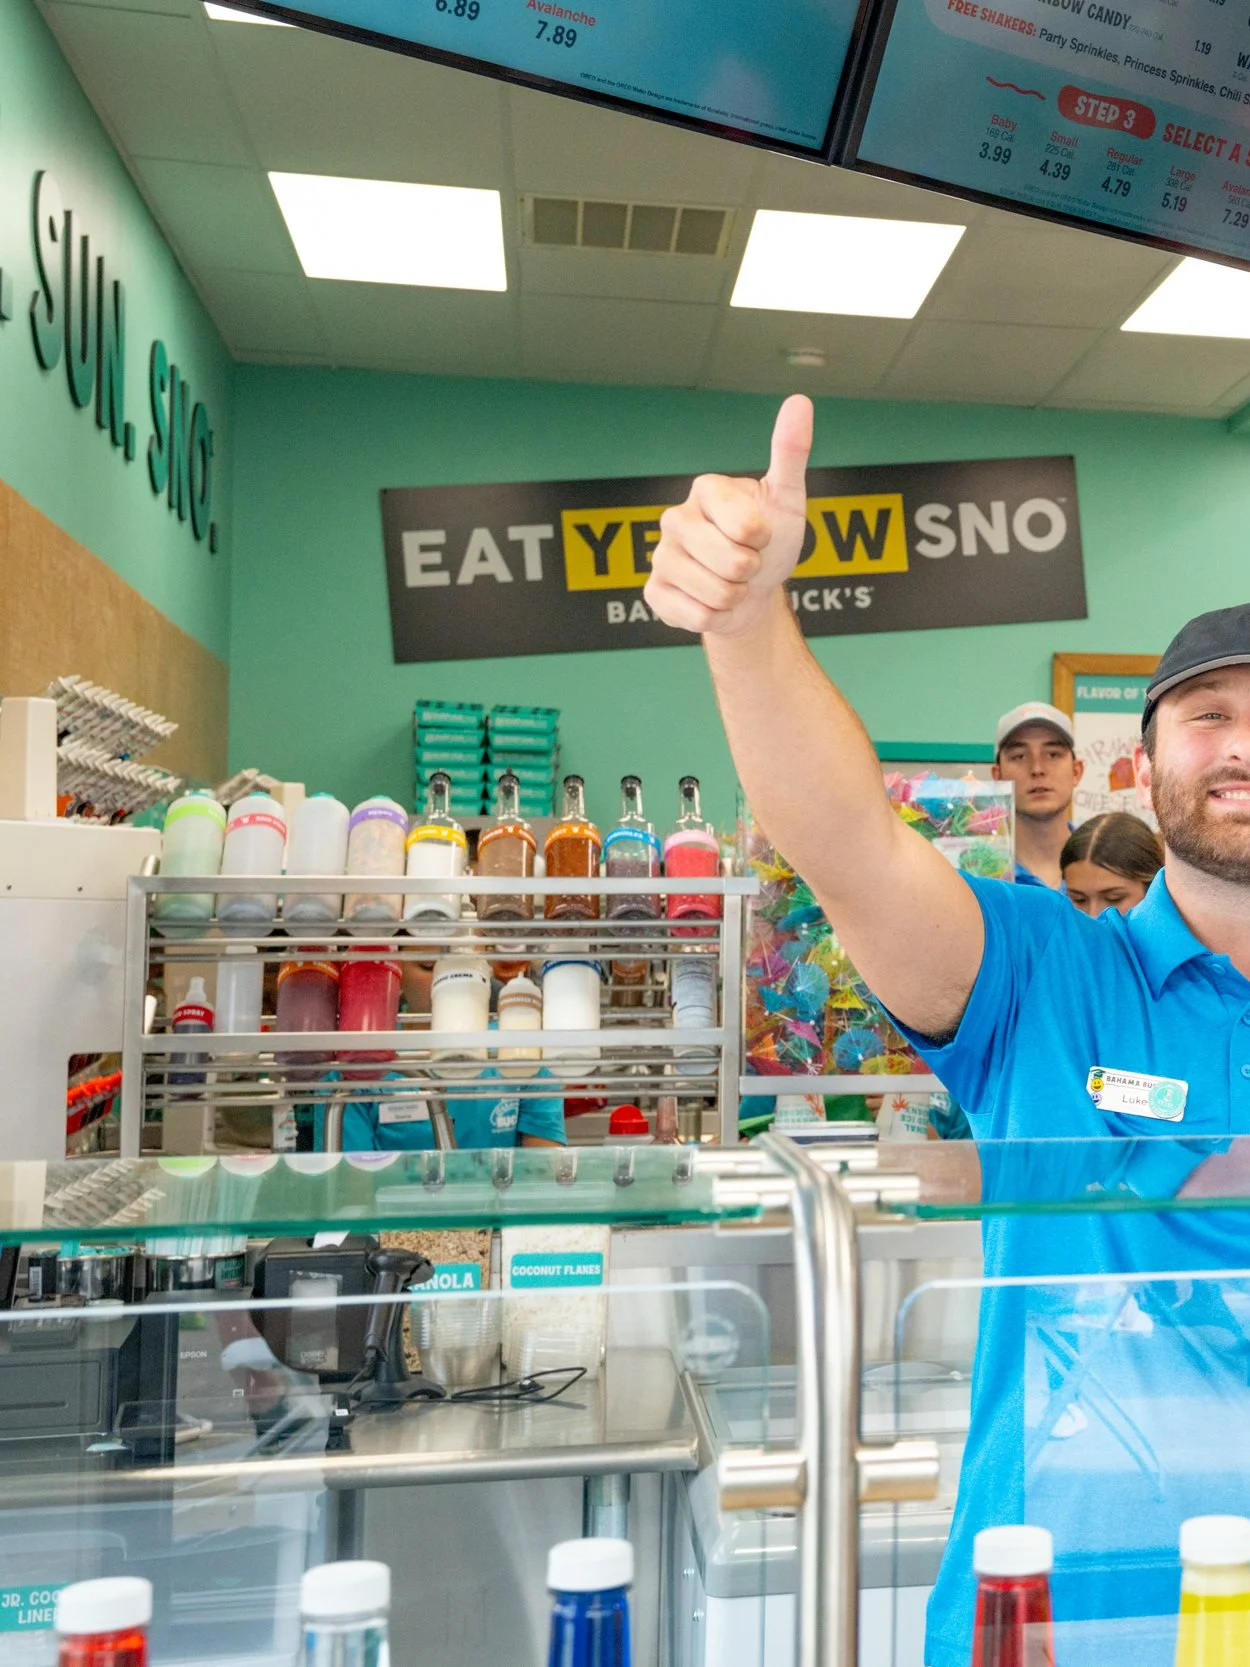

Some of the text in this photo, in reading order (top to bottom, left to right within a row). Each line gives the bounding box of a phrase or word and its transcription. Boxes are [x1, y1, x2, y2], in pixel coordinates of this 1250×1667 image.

[527, 0, 596, 26] Avalanche
[1087, 3, 1131, 30] CANDY
[535, 20, 577, 48] 7.89
[948, 0, 977, 18] FREE
[980, 8, 1037, 37] SHAKERS:
[1039, 28, 1067, 49] Party
[1069, 37, 1120, 65] Sprinkles,
[1123, 55, 1168, 79] Princess
[1169, 70, 1216, 95] Sprinkles,
[1220, 85, 1242, 102] Chili
[1194, 39, 1212, 55] 1.19
[1074, 95, 1137, 129] STEP 3
[986, 127, 1000, 138] 169
[991, 113, 1018, 132] Baby
[1044, 143, 1059, 155] 225
[1050, 131, 1079, 148] Small
[1162, 122, 1228, 158] SELECT
[1228, 143, 1242, 164] A
[979, 142, 1012, 164] 3.99
[1106, 147, 1143, 166] Regular
[1039, 159, 1071, 181] 4.39
[1170, 165, 1196, 181] Large
[1101, 176, 1131, 197] 4.79
[1161, 192, 1188, 213] 5.19
[1222, 208, 1250, 229] 7.29
[402, 524, 553, 588] EAT
[573, 508, 892, 577] YEW
[1076, 686, 1137, 699] FLAVOR OF
[1106, 1076, 1140, 1087] BAHAMA
[1132, 1094, 1158, 1106] Luke
[512, 1264, 600, 1276] COCONUT FLAKES
[180, 1350, 207, 1360] EPSON
